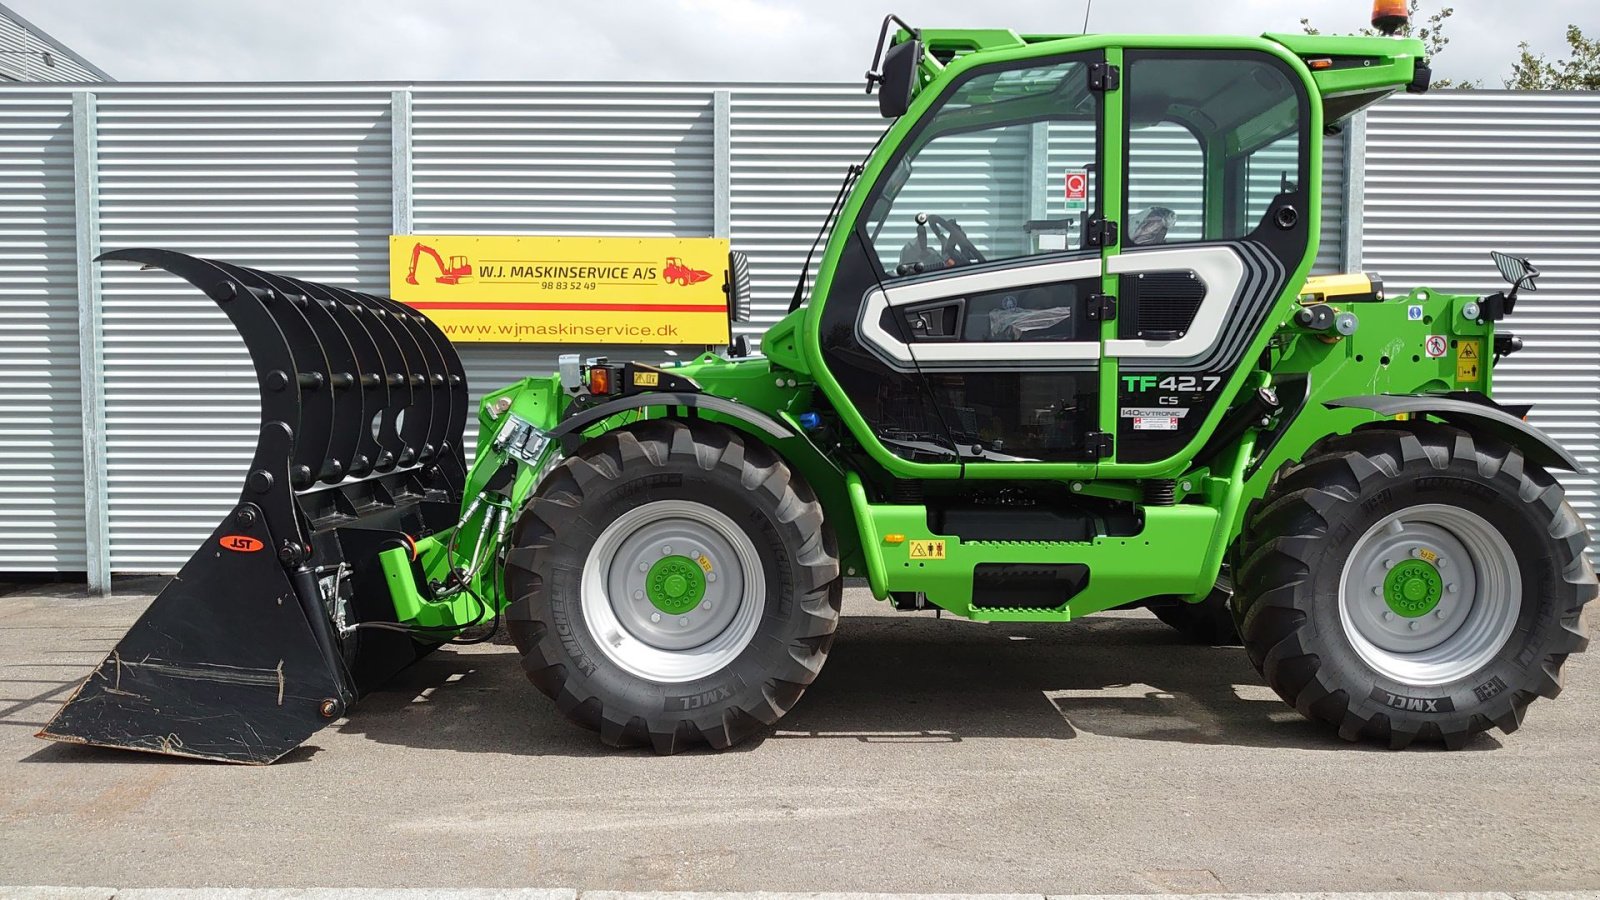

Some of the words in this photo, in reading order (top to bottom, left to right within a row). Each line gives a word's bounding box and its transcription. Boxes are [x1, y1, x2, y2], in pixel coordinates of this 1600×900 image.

[478, 265, 506, 279] W.J.
[510, 265, 629, 280] MASKINSERVICE
[632, 267, 657, 281] A/S
[541, 281, 554, 290] 98
[556, 281, 568, 290] 83
[570, 281, 582, 290] 52
[583, 281, 596, 291] 49
[443, 322, 678, 337] www.wjmaskinservice.dk
[1159, 396, 1179, 405] CS
[230, 538, 253, 549] JST
[680, 687, 731, 710] XMCL
[1386, 693, 1438, 712] XMCL
